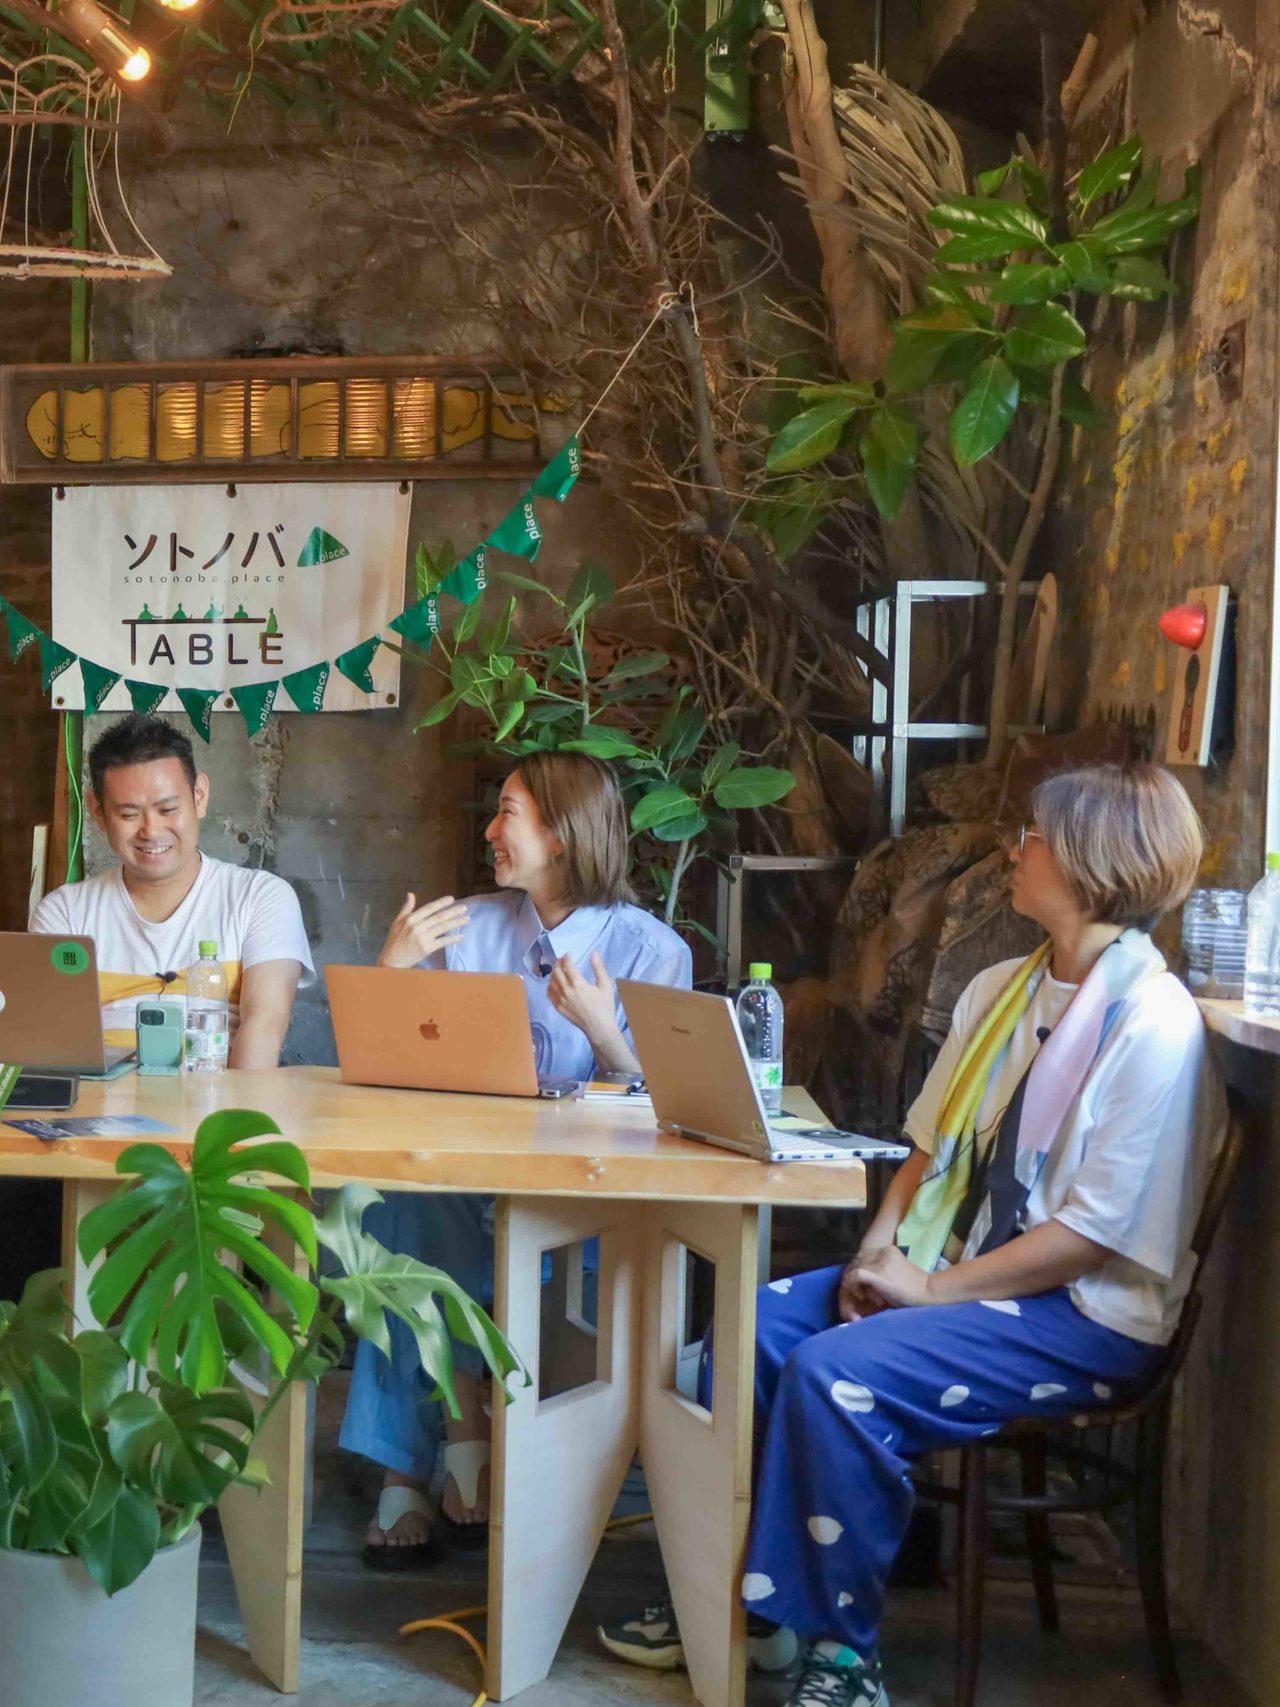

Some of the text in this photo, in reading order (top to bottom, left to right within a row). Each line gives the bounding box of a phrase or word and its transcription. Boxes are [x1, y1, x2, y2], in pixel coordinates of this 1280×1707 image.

[568, 448, 580, 477] lace
[124, 524, 285, 571] ソトノバ
[123, 574, 285, 584] sotonoba.place
[122, 618, 284, 666] TABLE
[48, 658, 71, 684] .place
[260, 690, 275, 727] .place
[313, 671, 328, 711] .place
[202, 696, 215, 730] .place
